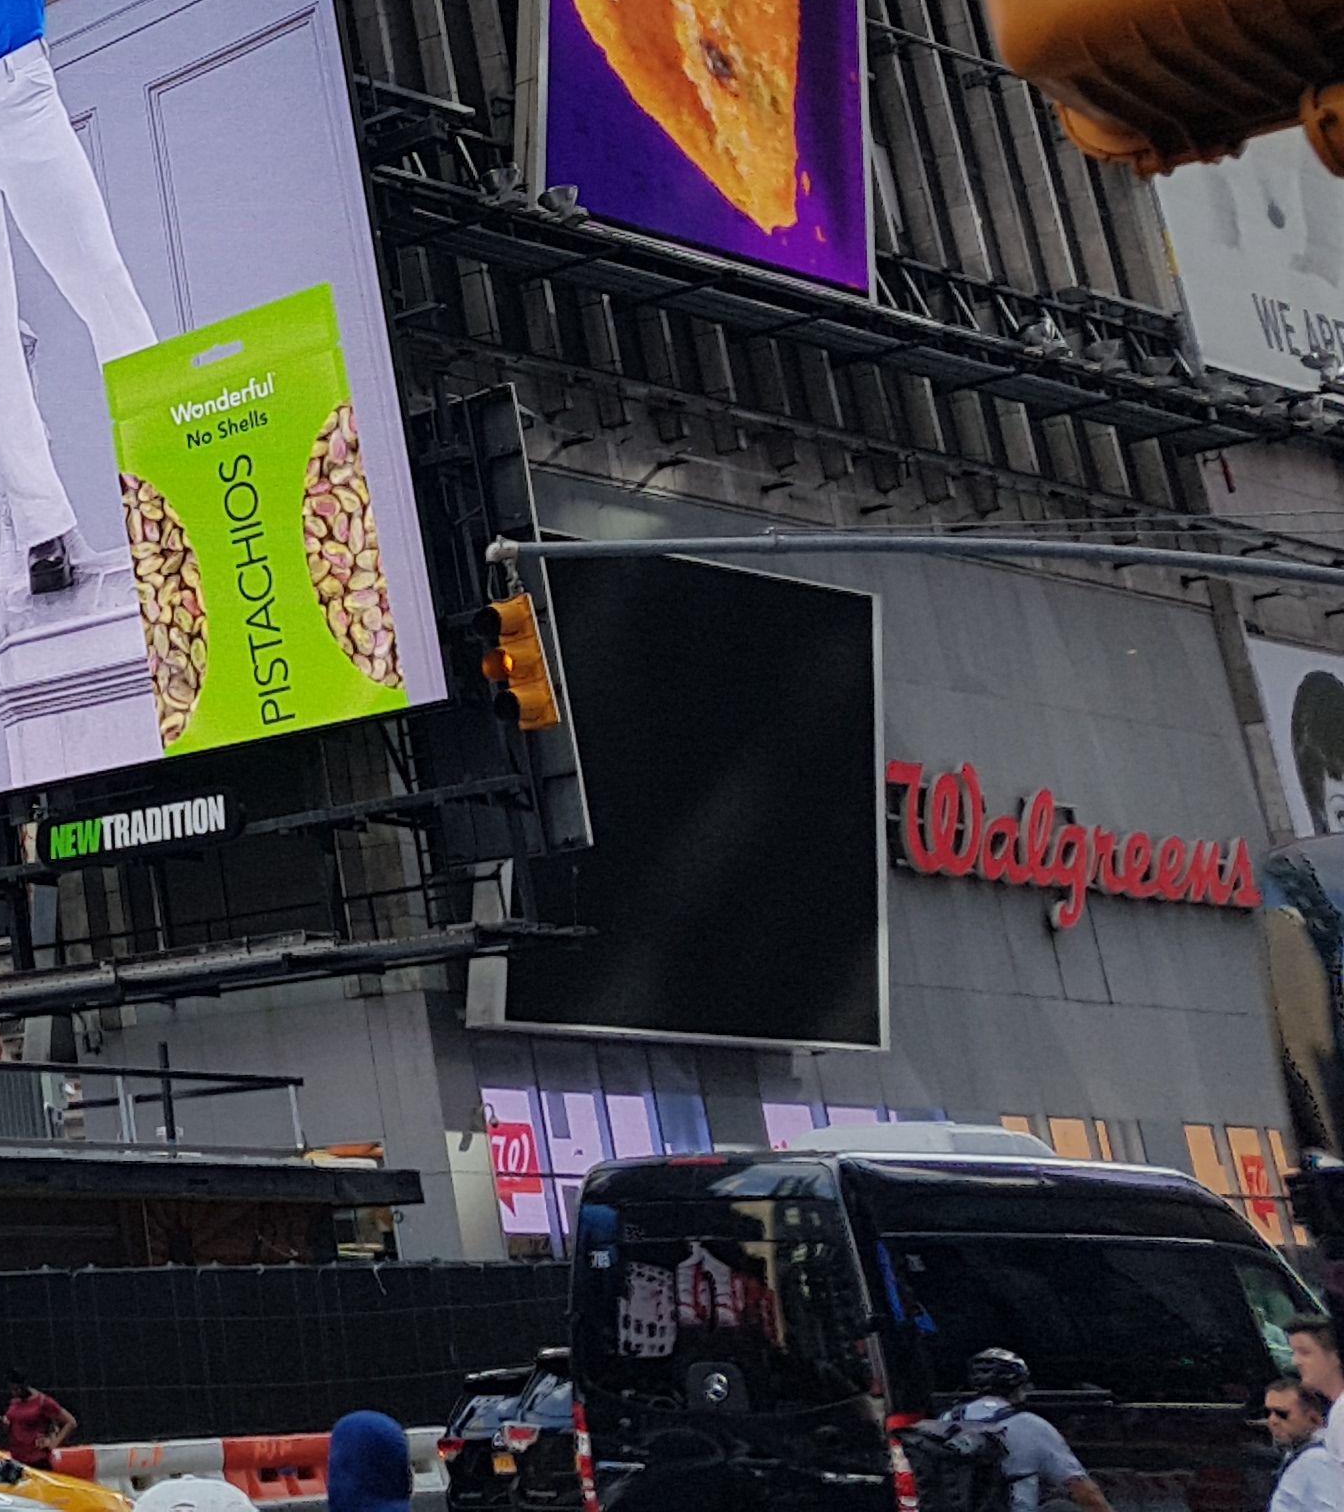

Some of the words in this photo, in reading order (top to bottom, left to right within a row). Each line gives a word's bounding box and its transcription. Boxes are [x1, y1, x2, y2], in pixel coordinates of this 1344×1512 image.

[1252, 292, 1301, 356] WE
[171, 372, 274, 425] Wonderful
[186, 430, 212, 450] No
[218, 410, 269, 440] Shells
[218, 453, 296, 726] PISTACHIOS
[886, 760, 1263, 928] Walgreens
